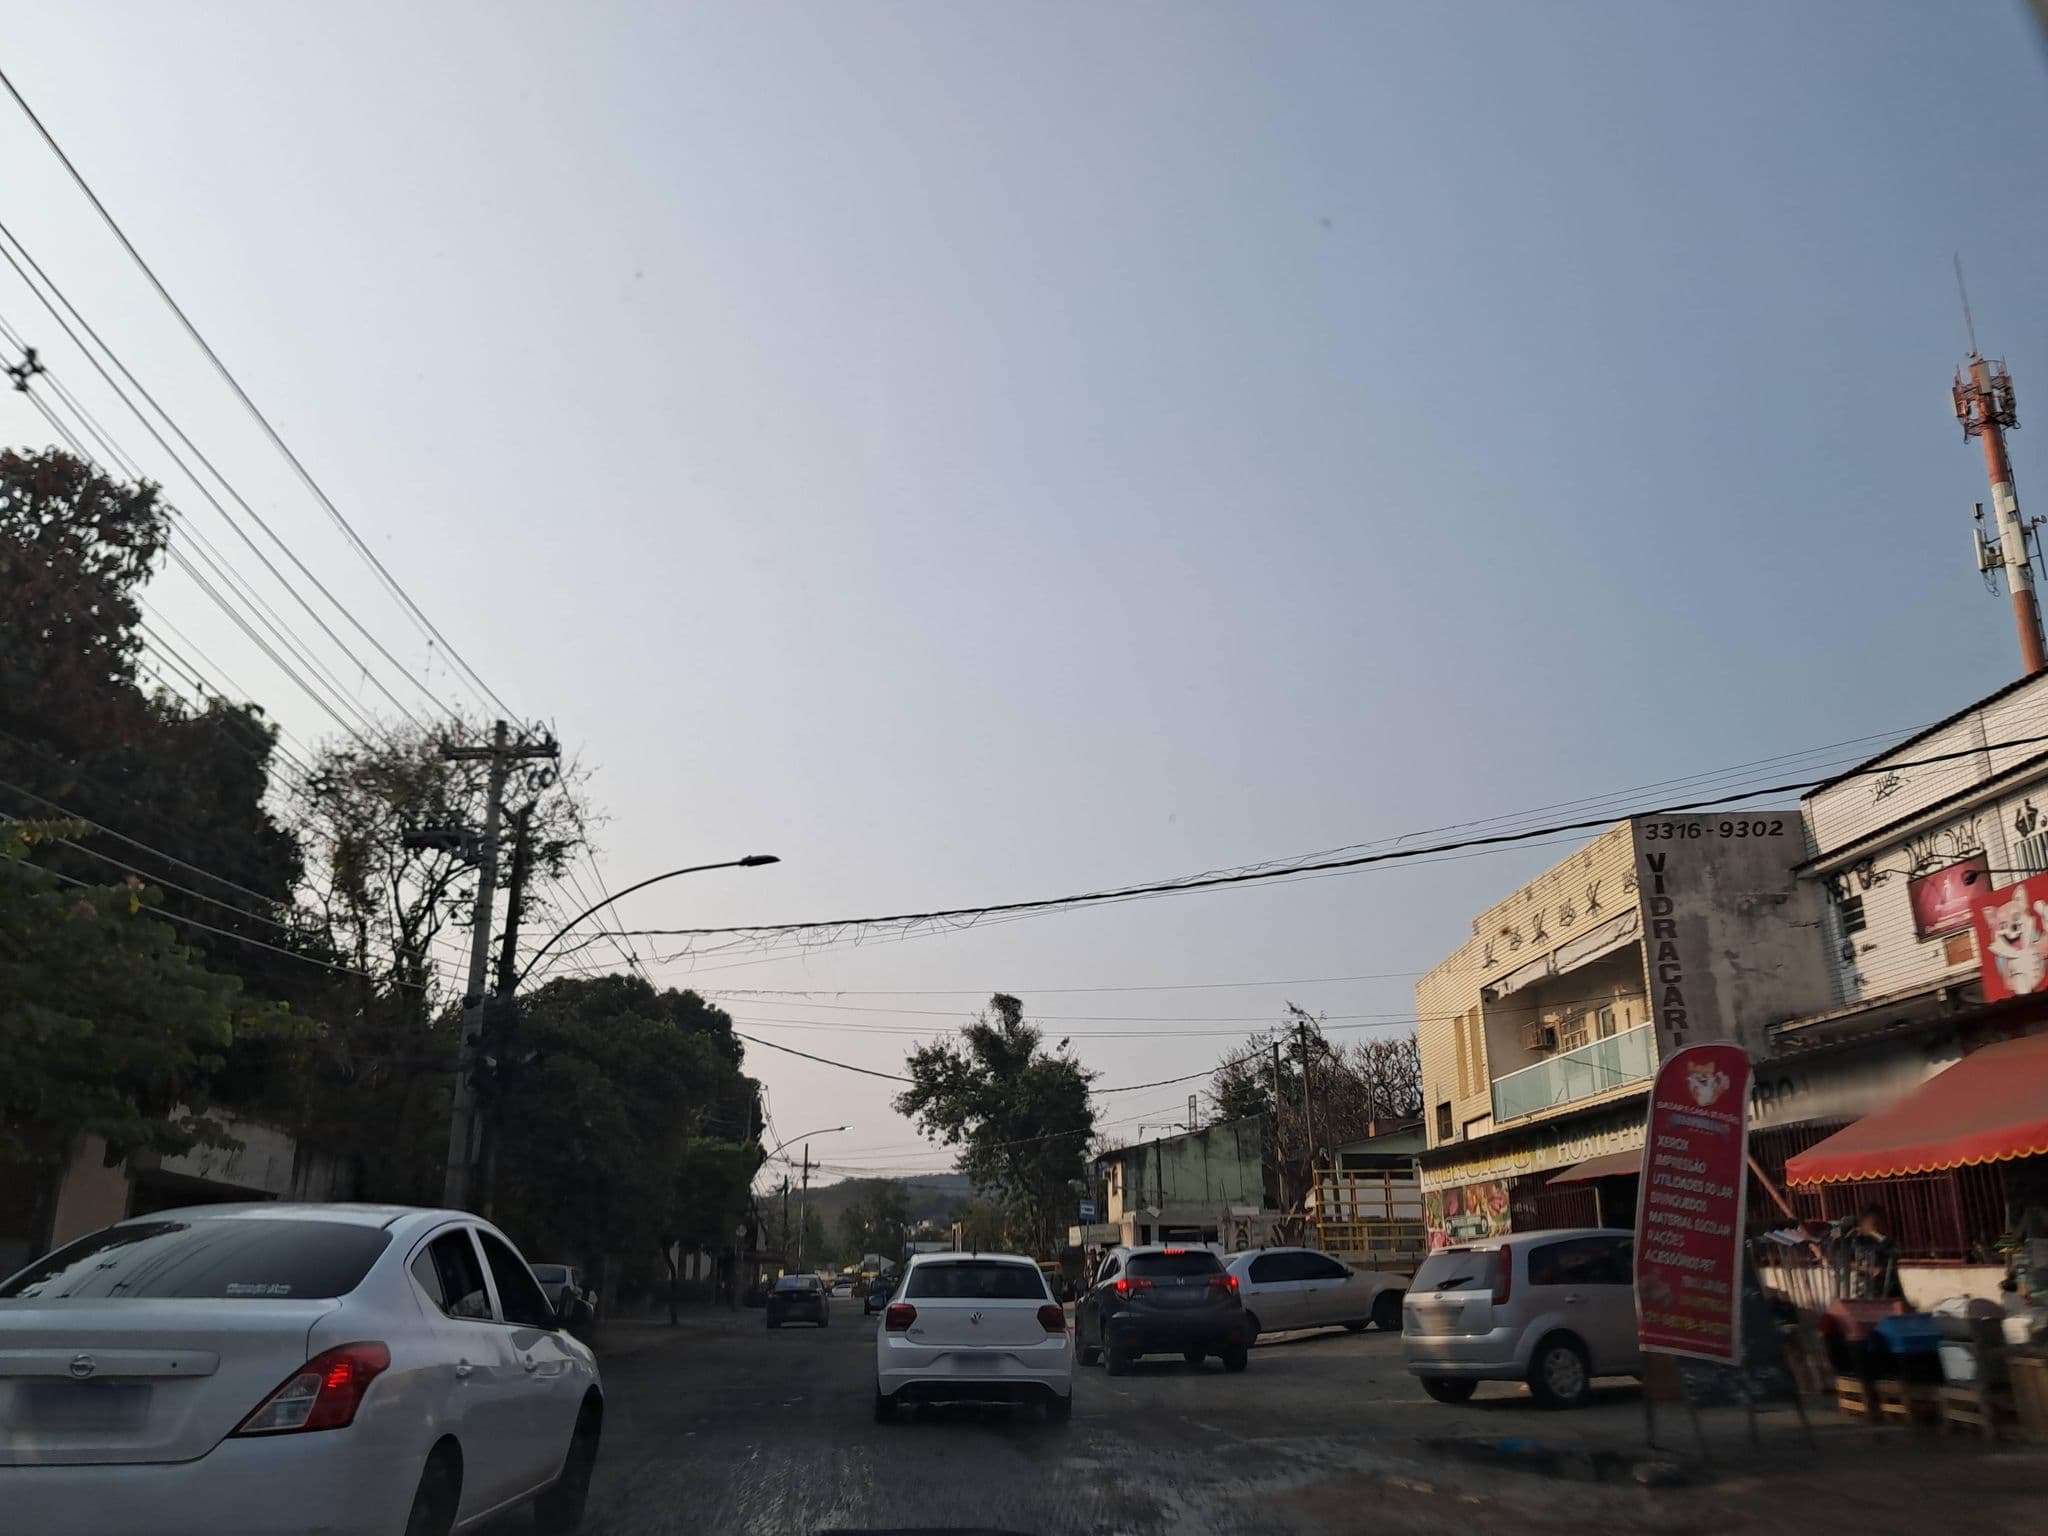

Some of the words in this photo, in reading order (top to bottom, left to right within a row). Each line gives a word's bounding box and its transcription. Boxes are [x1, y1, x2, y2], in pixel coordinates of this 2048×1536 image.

[1645, 820, 1784, 840] 3316-9302
[1653, 1173, 1704, 1194] UTILIDADES
[1717, 1184, 1734, 1201] LAR
[1648, 1210, 1694, 1231] MATERIAL
